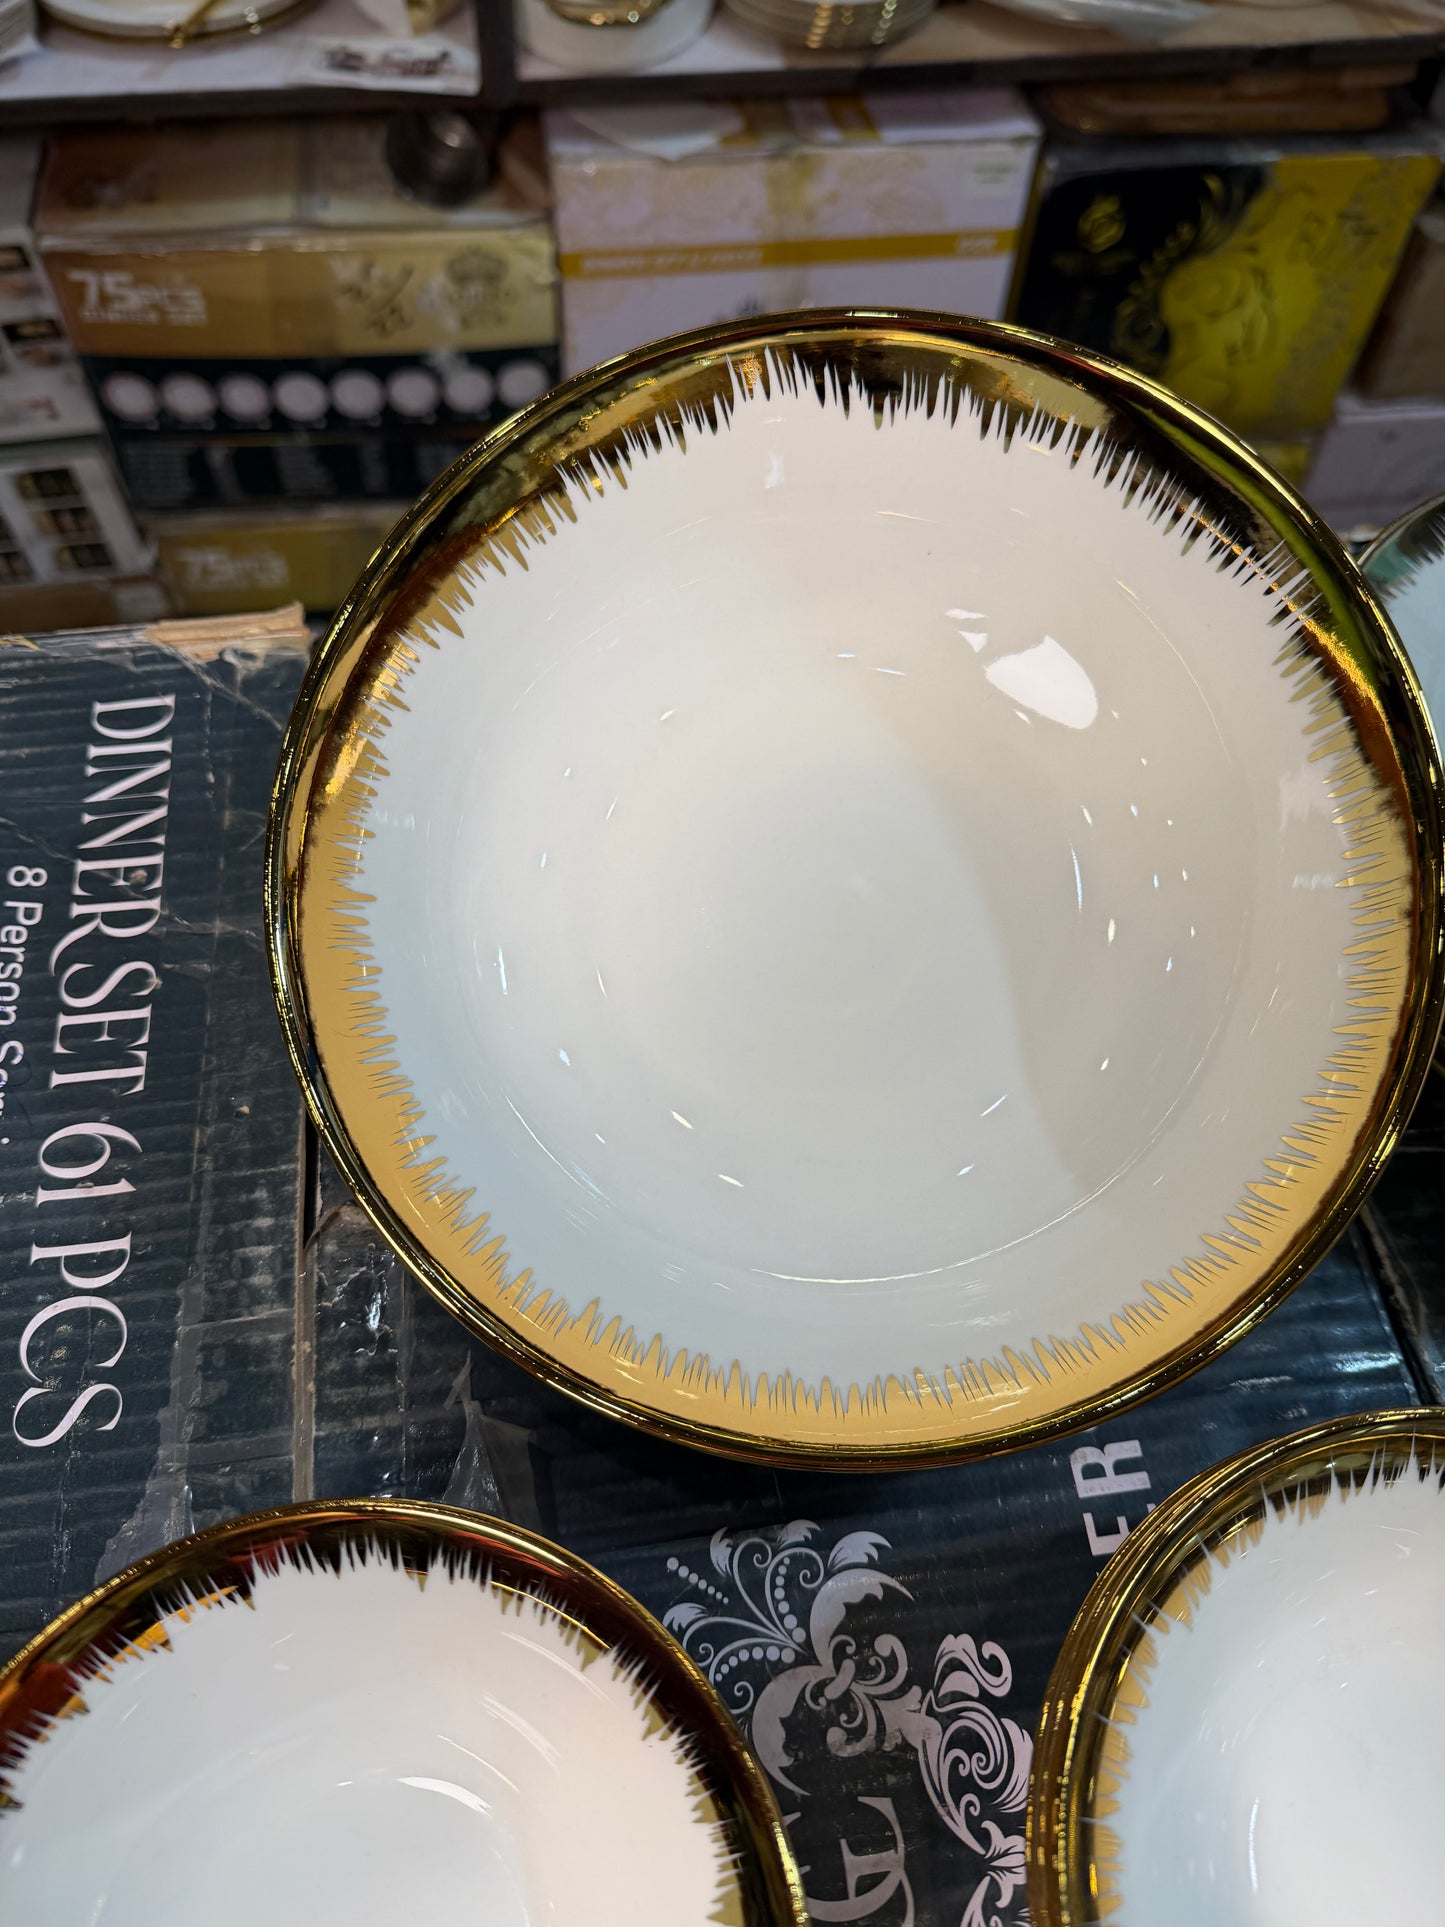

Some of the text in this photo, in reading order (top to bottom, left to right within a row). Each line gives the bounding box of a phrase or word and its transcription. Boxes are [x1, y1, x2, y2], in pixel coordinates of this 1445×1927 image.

[7, 865, 48, 887] 8
[13, 693, 176, 1447] DINNER SET 61 PCS
